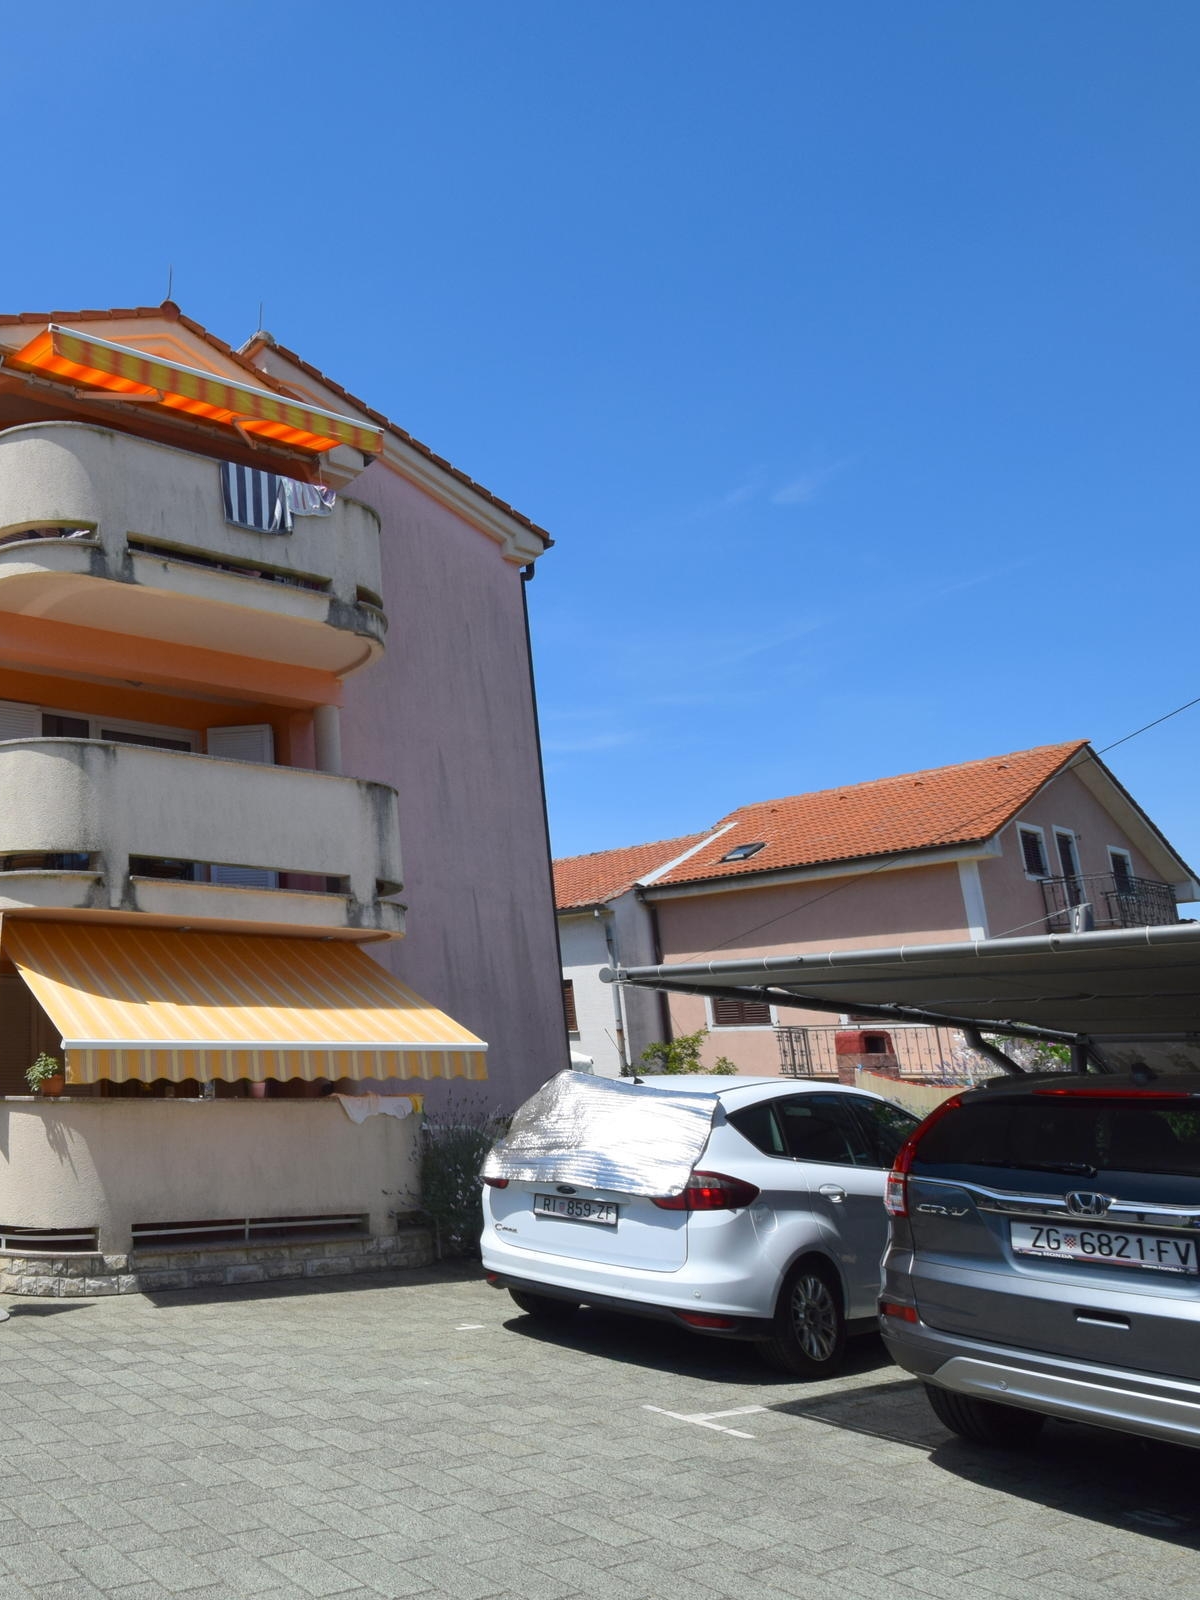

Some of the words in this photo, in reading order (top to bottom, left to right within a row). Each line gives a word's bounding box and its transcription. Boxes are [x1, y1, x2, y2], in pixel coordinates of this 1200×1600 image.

[543, 1198, 556, 1213] RI
[1030, 1226, 1061, 1251] ZG
[1042, 1252, 1074, 1260] HONDA
